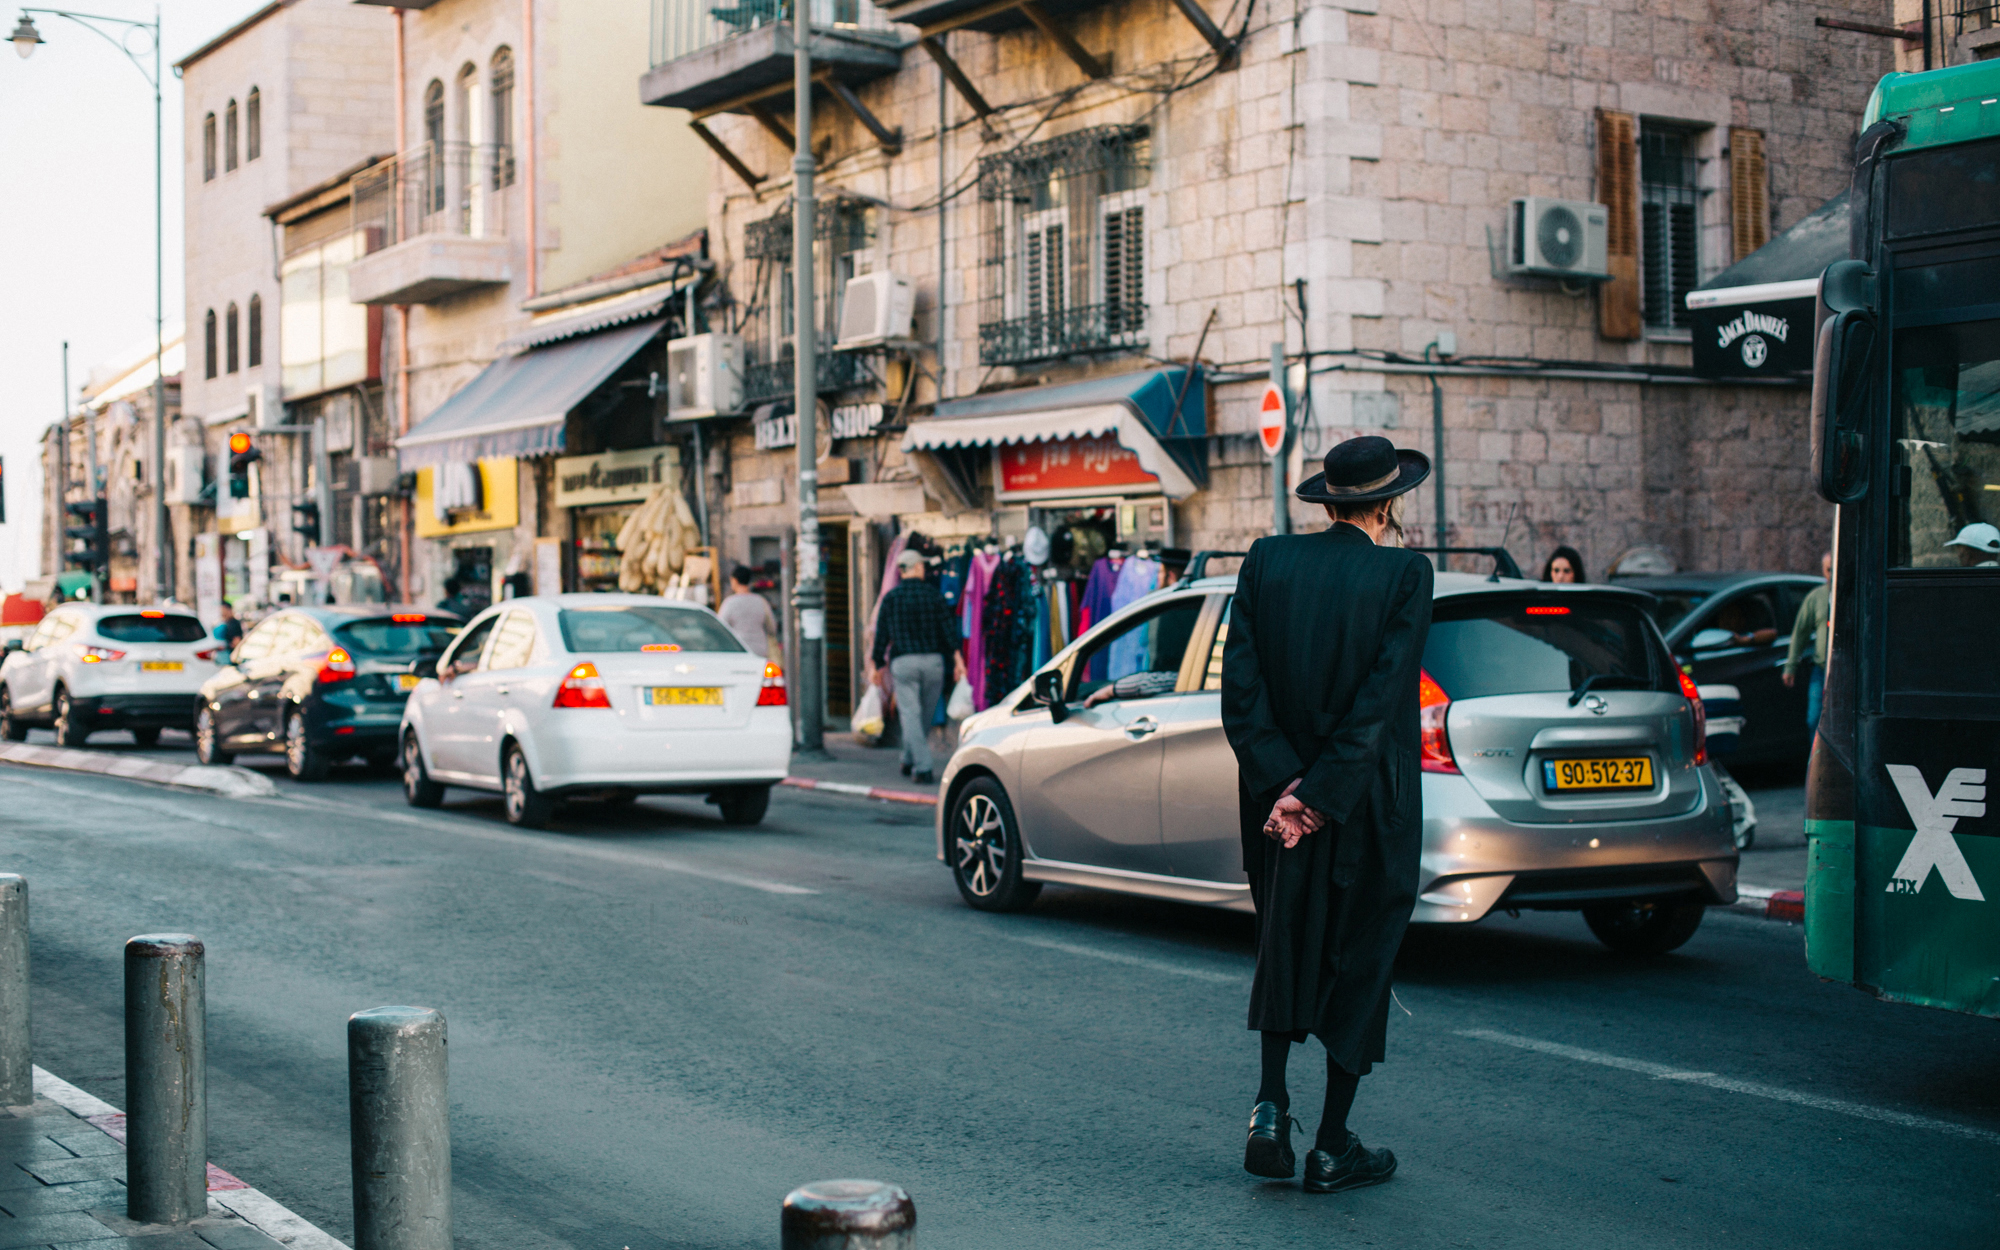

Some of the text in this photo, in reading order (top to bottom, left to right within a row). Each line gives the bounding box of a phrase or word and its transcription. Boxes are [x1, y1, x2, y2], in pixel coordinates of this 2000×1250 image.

[1718, 310, 1790, 348] JACK DANIEL'S
[832, 403, 884, 440] SHOP
